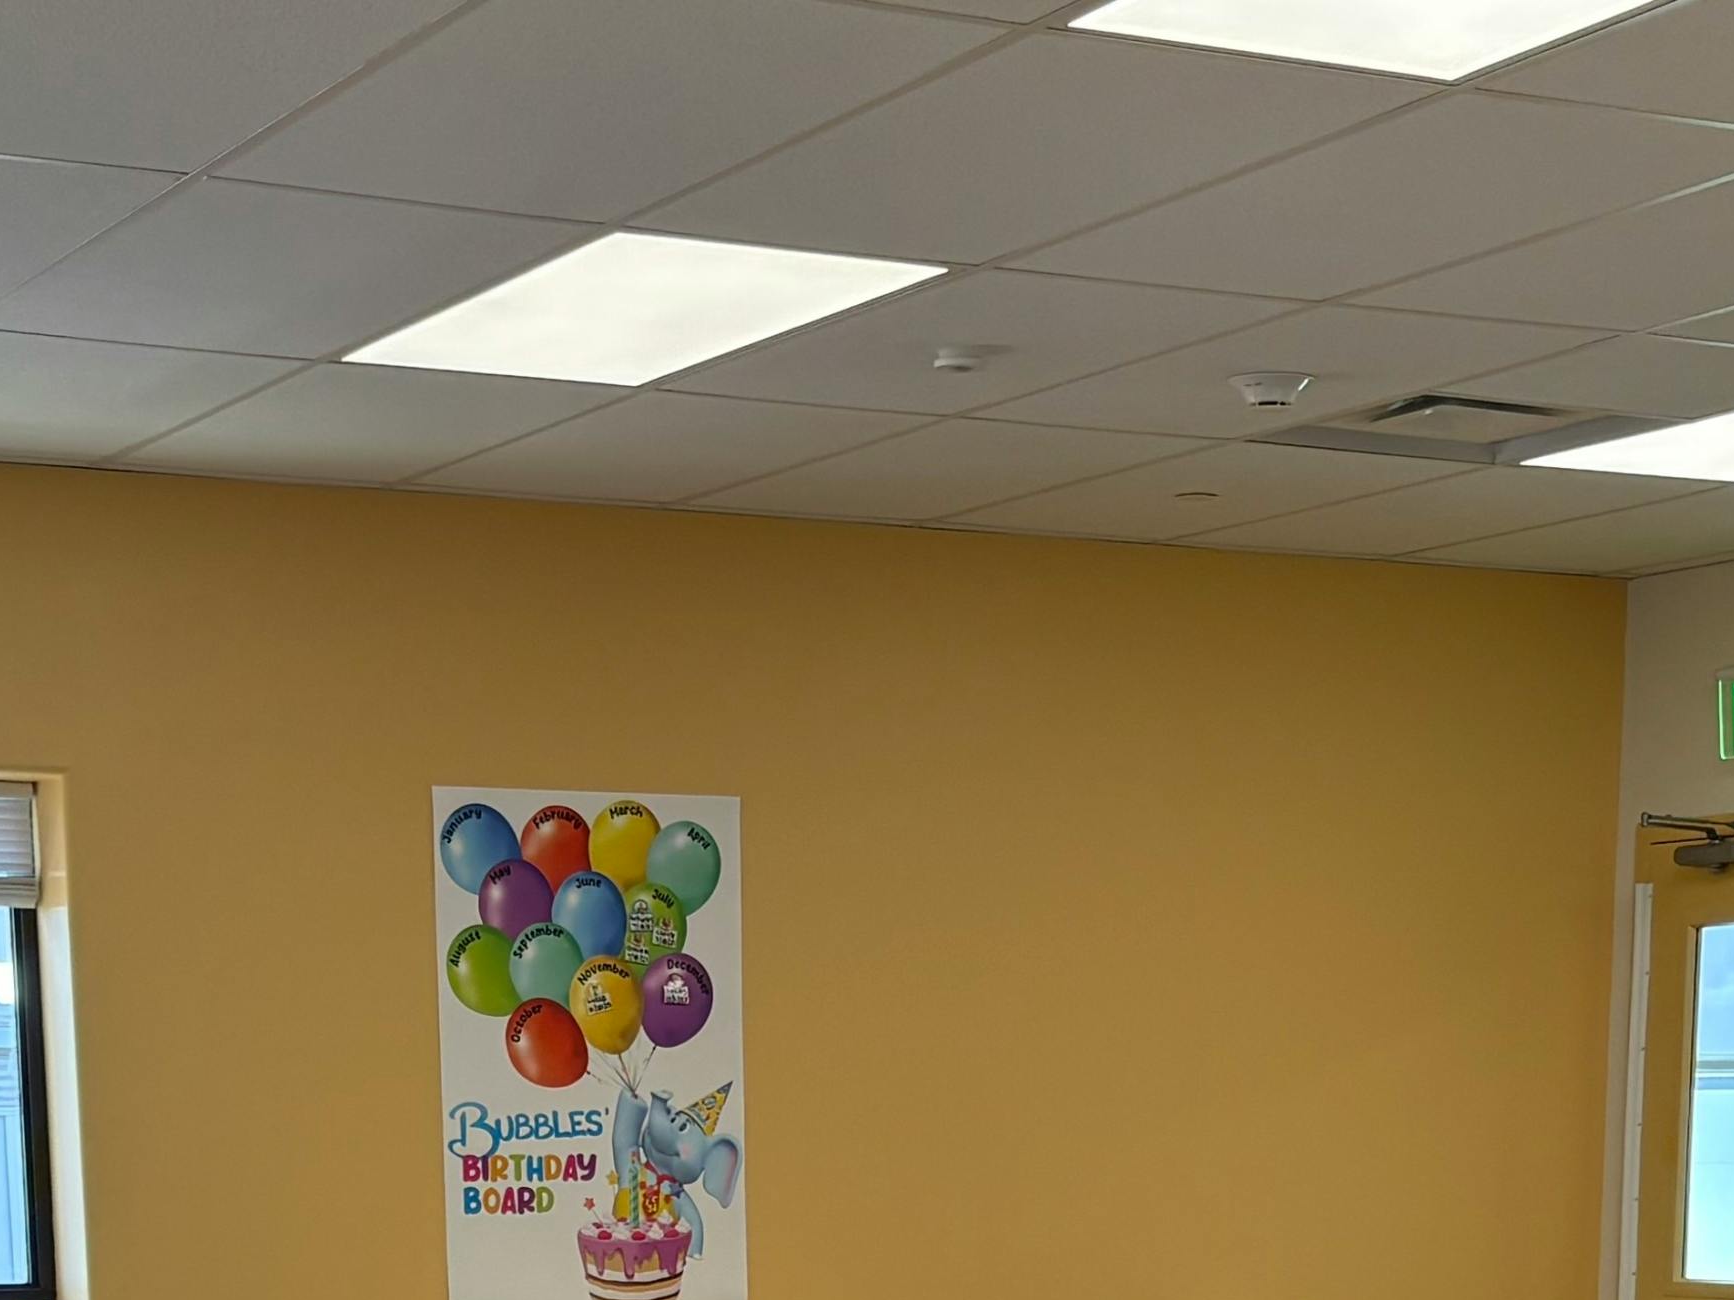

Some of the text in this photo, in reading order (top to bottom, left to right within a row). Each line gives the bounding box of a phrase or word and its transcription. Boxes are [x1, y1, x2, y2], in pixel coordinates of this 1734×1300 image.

[442, 807, 482, 843] January
[532, 809, 583, 830] February
[610, 805, 643, 819] March
[687, 827, 710, 850] April
[490, 865, 511, 884] May
[575, 877, 602, 889] June
[652, 888, 675, 909] July
[449, 931, 481, 967] August
[513, 925, 564, 959] September
[577, 963, 629, 986] November
[666, 957, 710, 996] December
[511, 1004, 542, 1043] October
[448, 1102, 609, 1159] BUBBLES'
[462, 1153, 597, 1182] BIRTHDAY
[463, 1186, 554, 1215] BOARD
